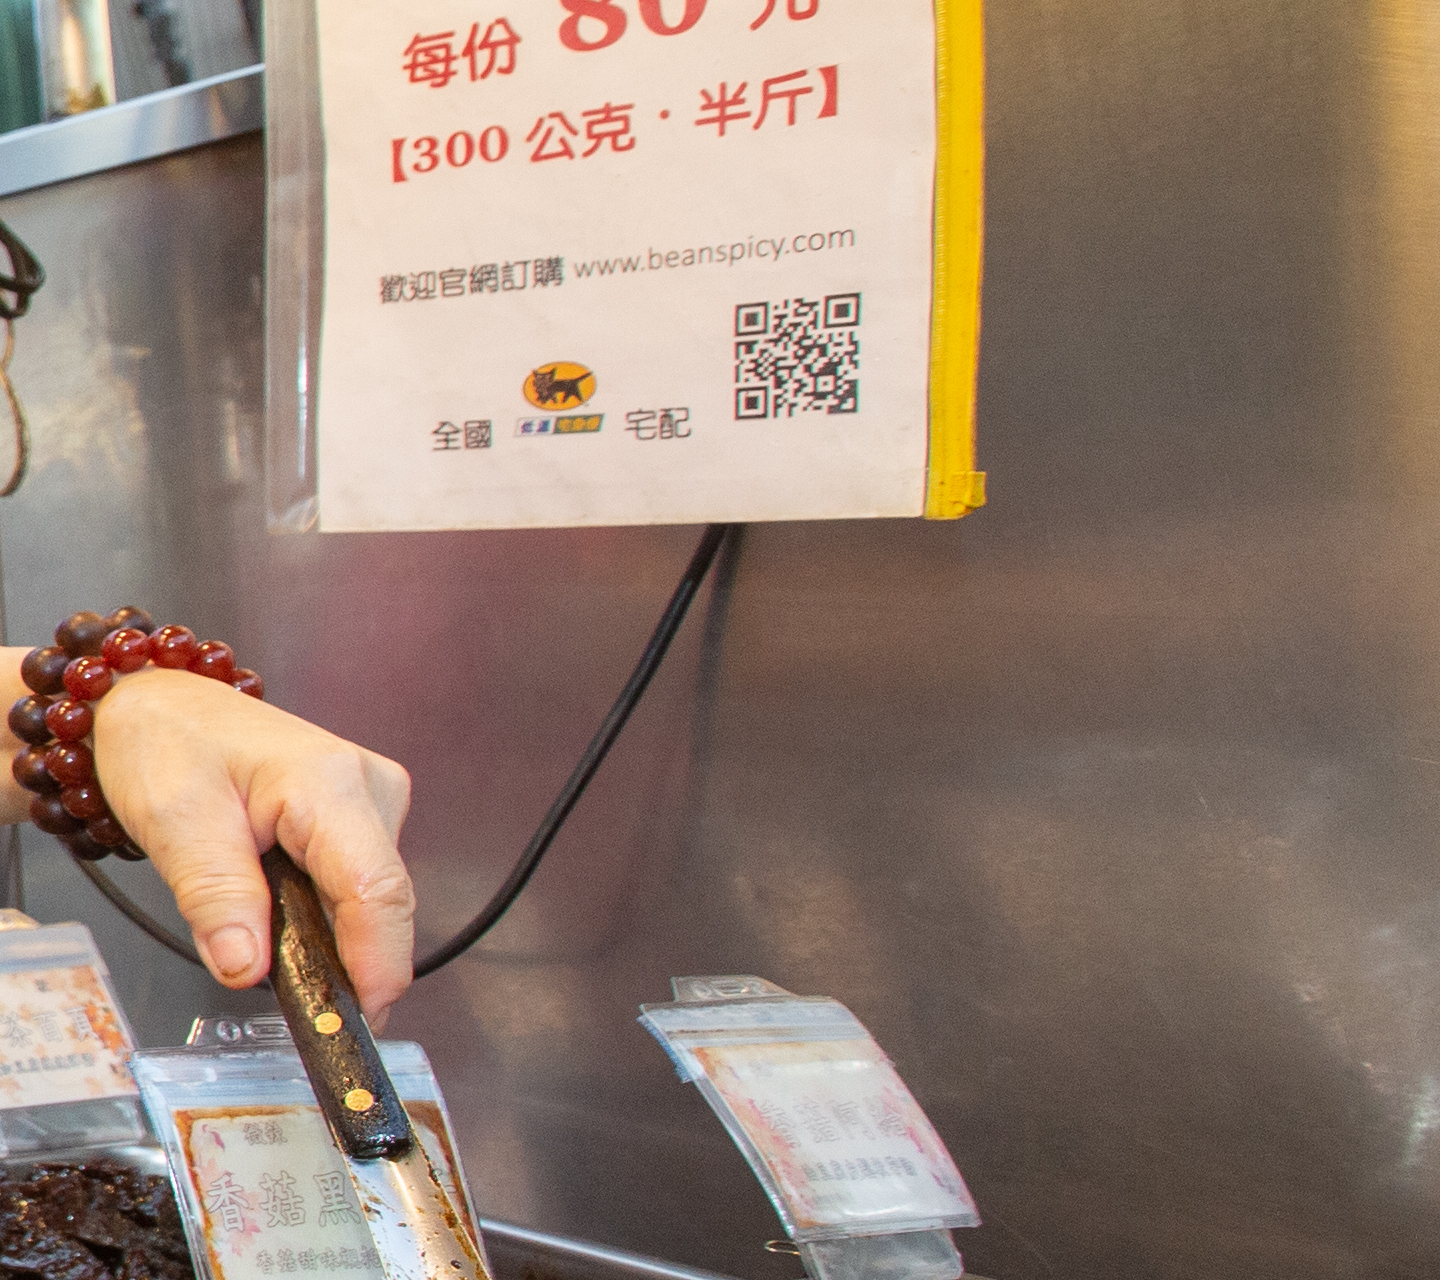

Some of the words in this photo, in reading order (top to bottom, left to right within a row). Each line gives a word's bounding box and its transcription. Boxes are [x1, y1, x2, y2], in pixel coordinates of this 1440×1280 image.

[401, 17, 523, 90] 每份
[574, 223, 856, 282] www.beanspicy.com
[431, 419, 492, 451] 全國
[623, 407, 692, 440] 宅配
